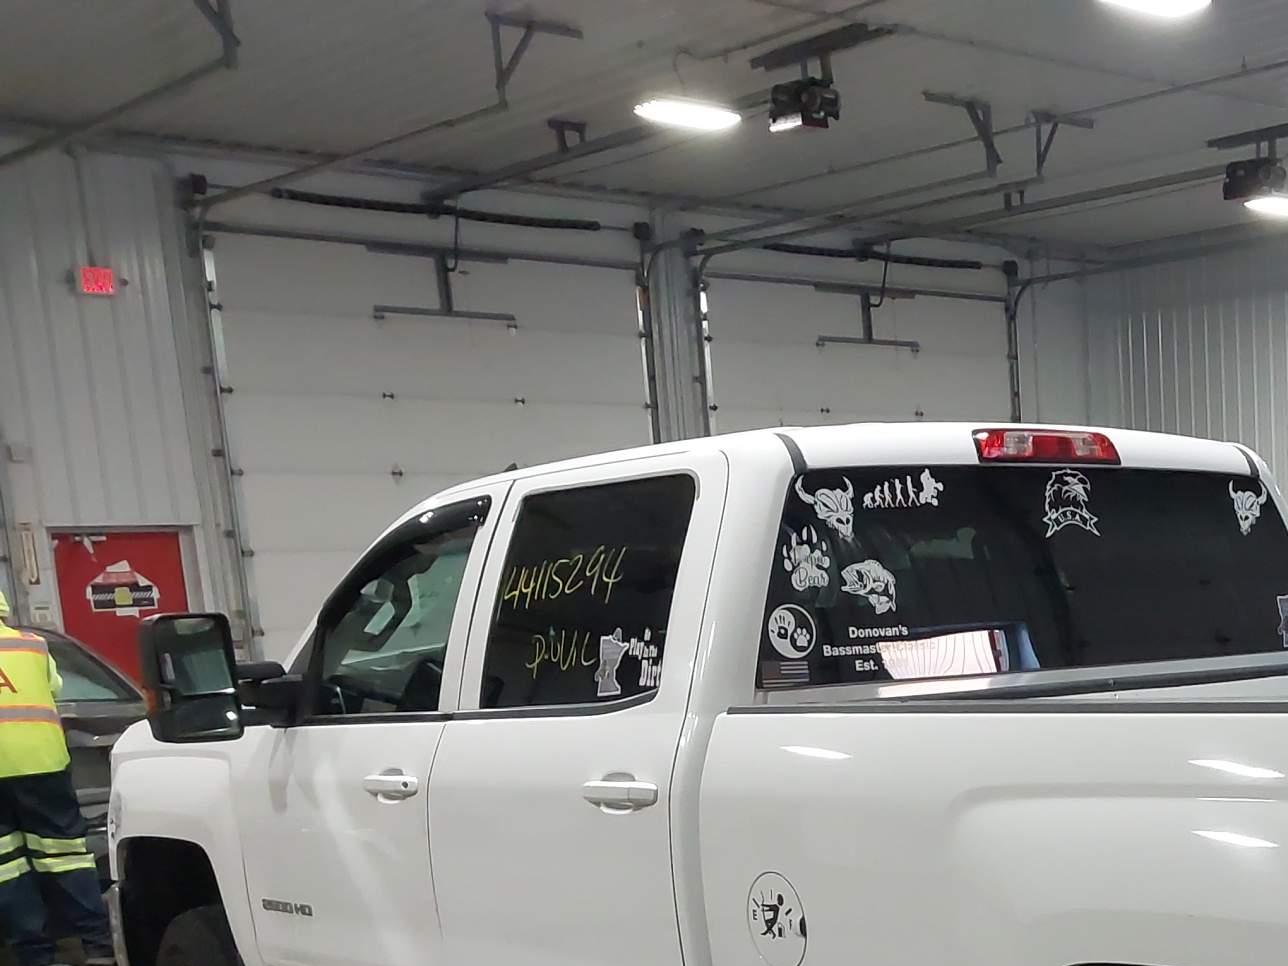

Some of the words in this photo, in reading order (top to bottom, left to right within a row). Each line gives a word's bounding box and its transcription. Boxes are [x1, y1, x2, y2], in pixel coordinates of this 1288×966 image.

[503, 545, 627, 609] 44115294
[848, 625, 909, 638] Donovan's
[855, 659, 879, 671] Est.
